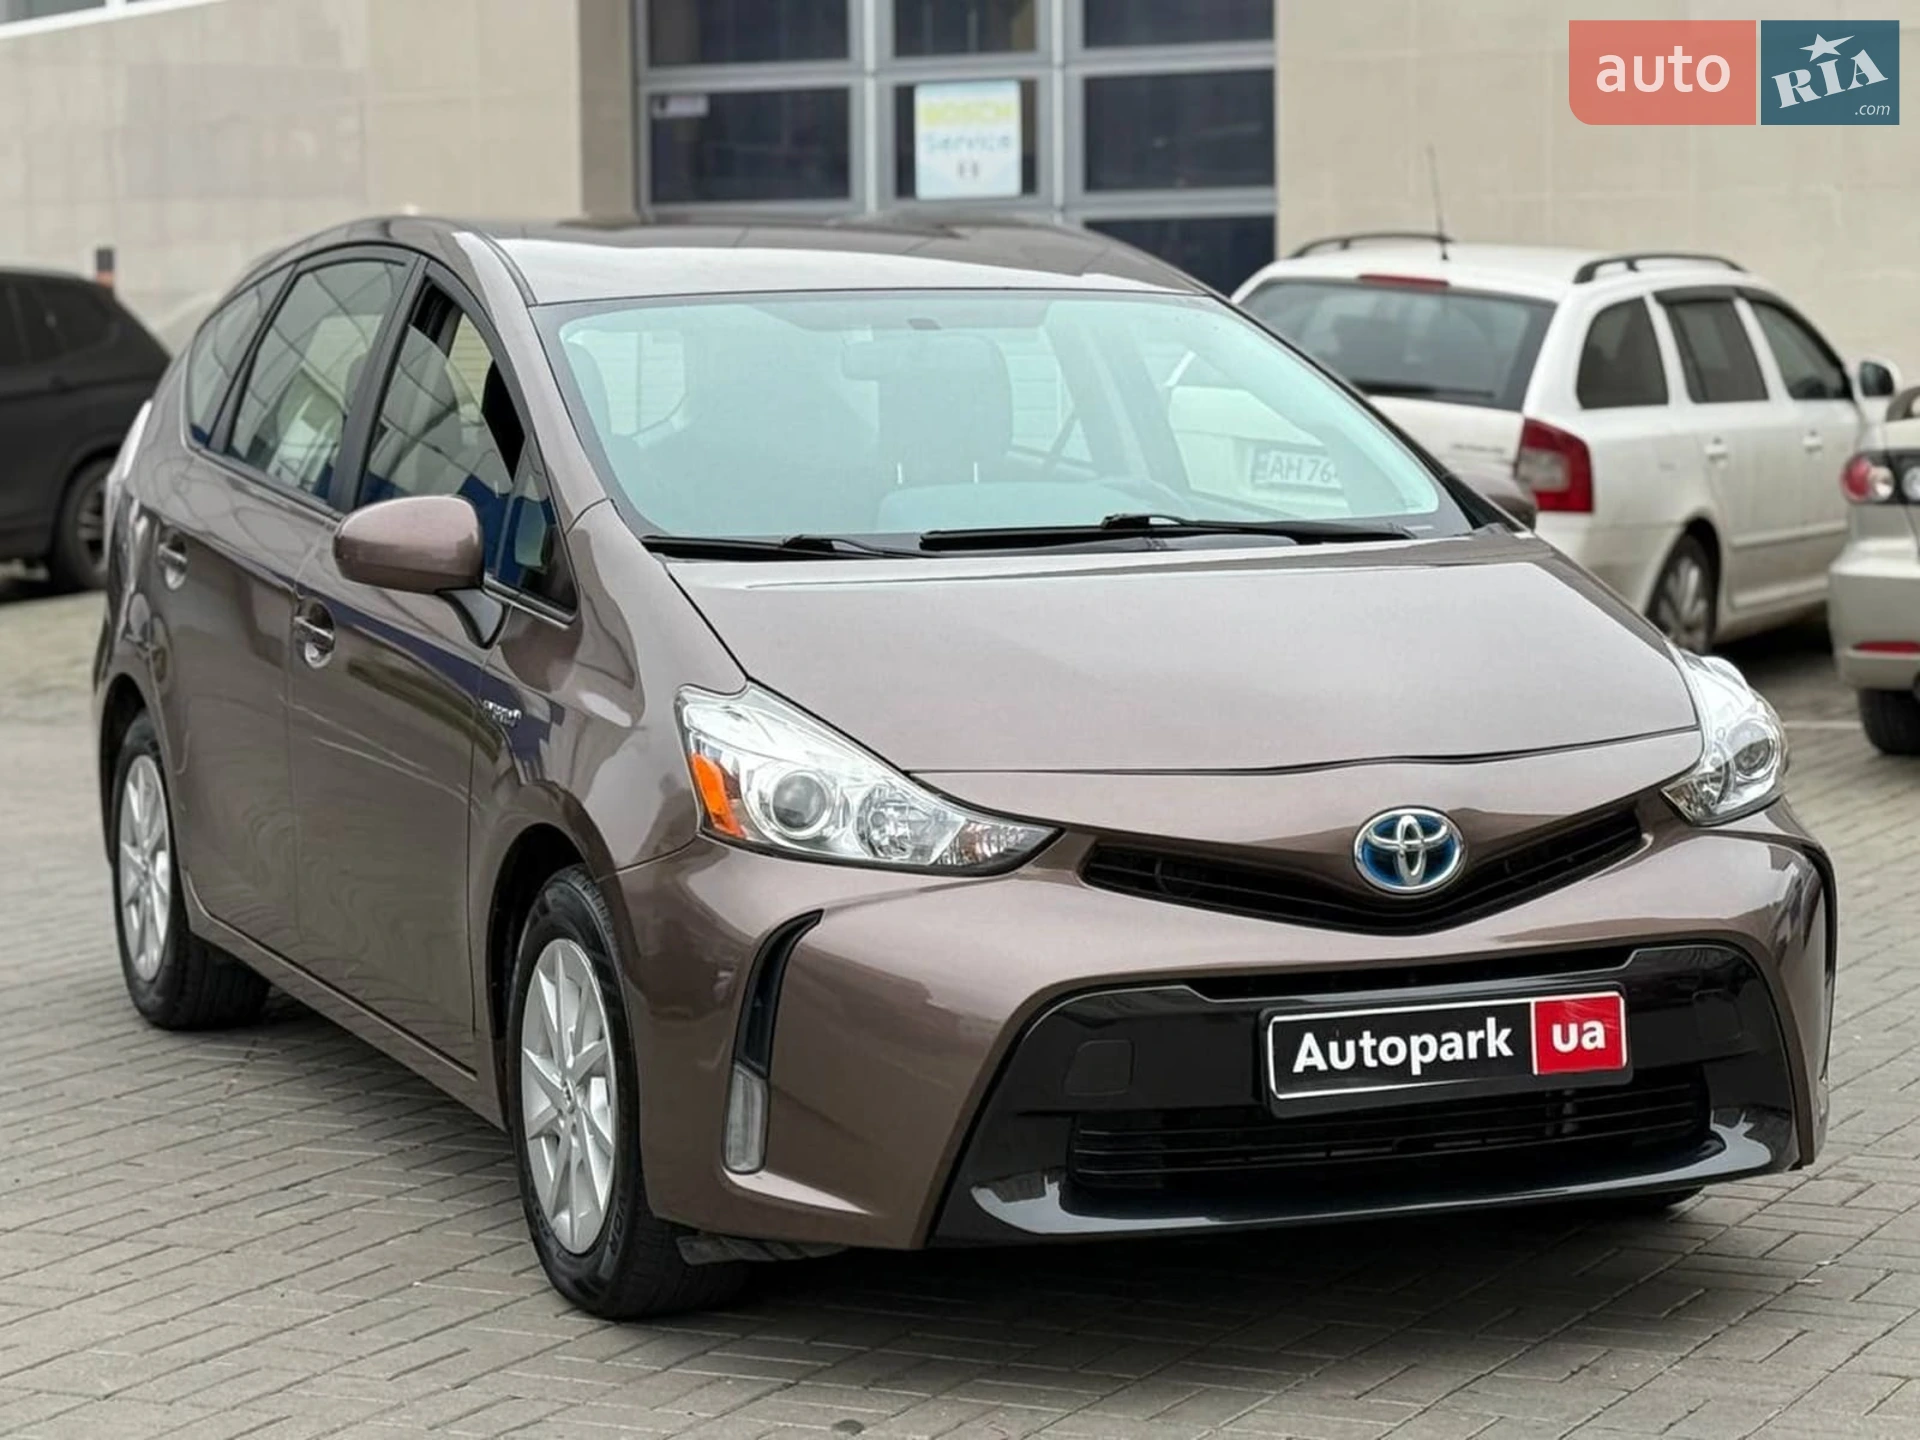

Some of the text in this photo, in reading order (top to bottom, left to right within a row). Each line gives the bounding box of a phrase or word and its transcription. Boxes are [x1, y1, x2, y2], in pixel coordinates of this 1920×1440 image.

[1307, 458, 1339, 483] 76
[1292, 1017, 1606, 1075] Autopark ua
